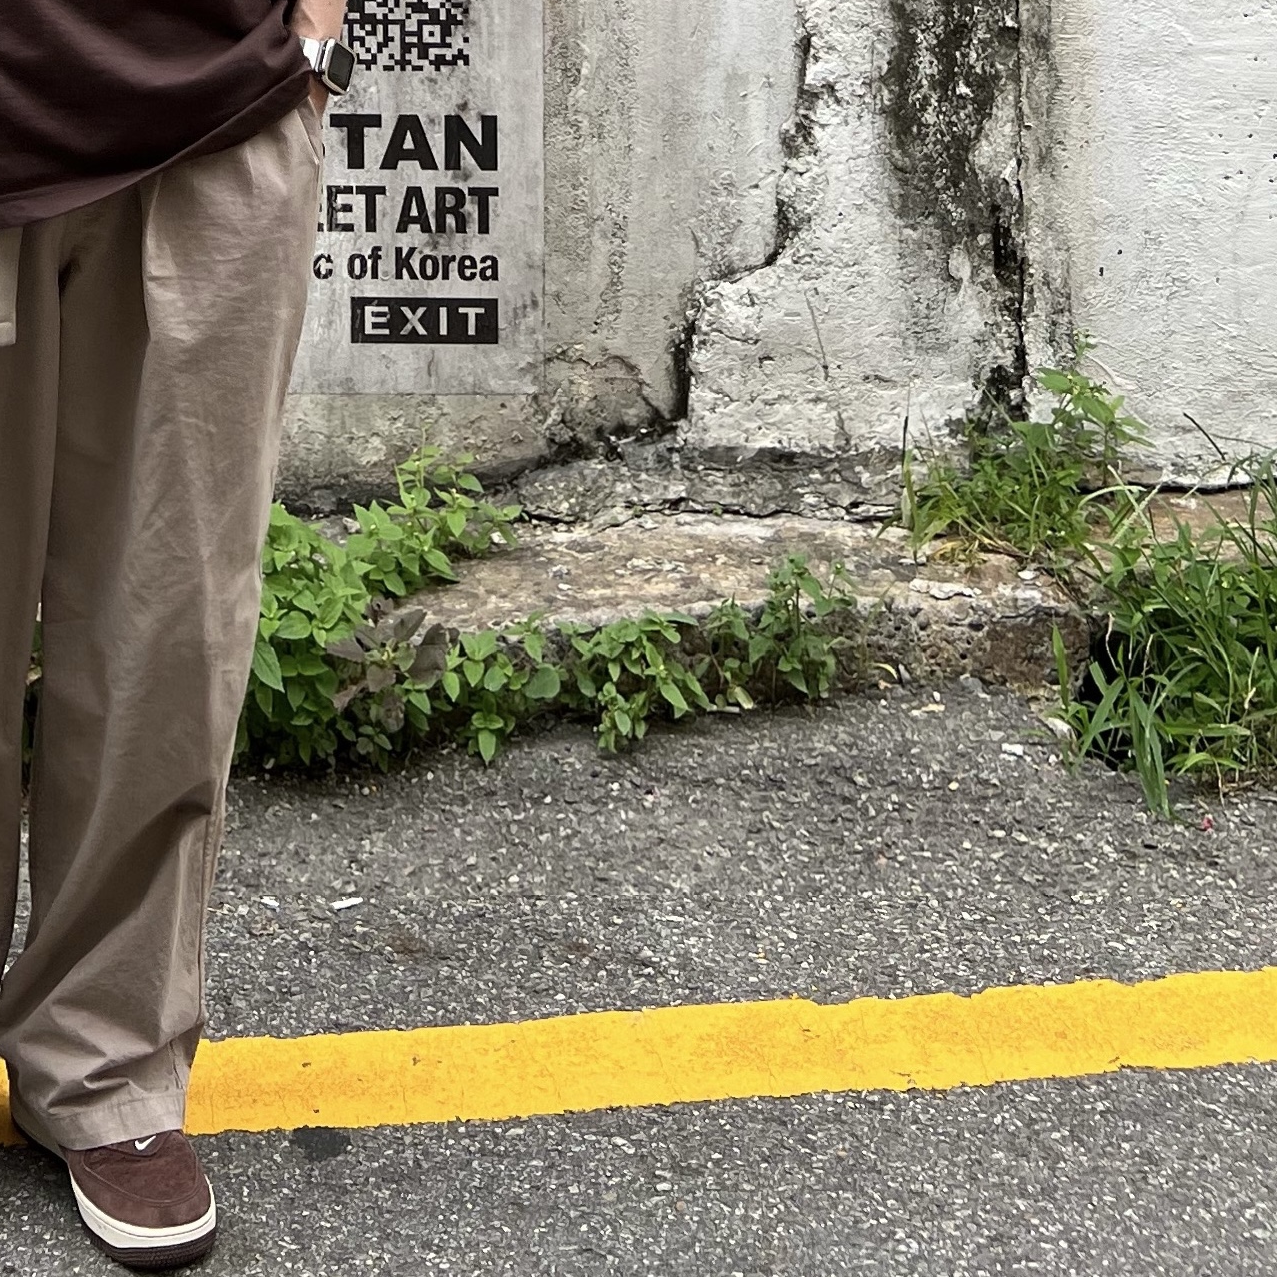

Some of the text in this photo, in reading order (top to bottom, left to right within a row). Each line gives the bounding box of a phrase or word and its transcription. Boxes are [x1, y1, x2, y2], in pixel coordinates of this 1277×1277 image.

[330, 113, 498, 171] TAN
[317, 185, 499, 235] ET ART
[347, 245, 382, 280] of
[394, 246, 499, 281] Korea
[364, 305, 486, 336] EXIT
